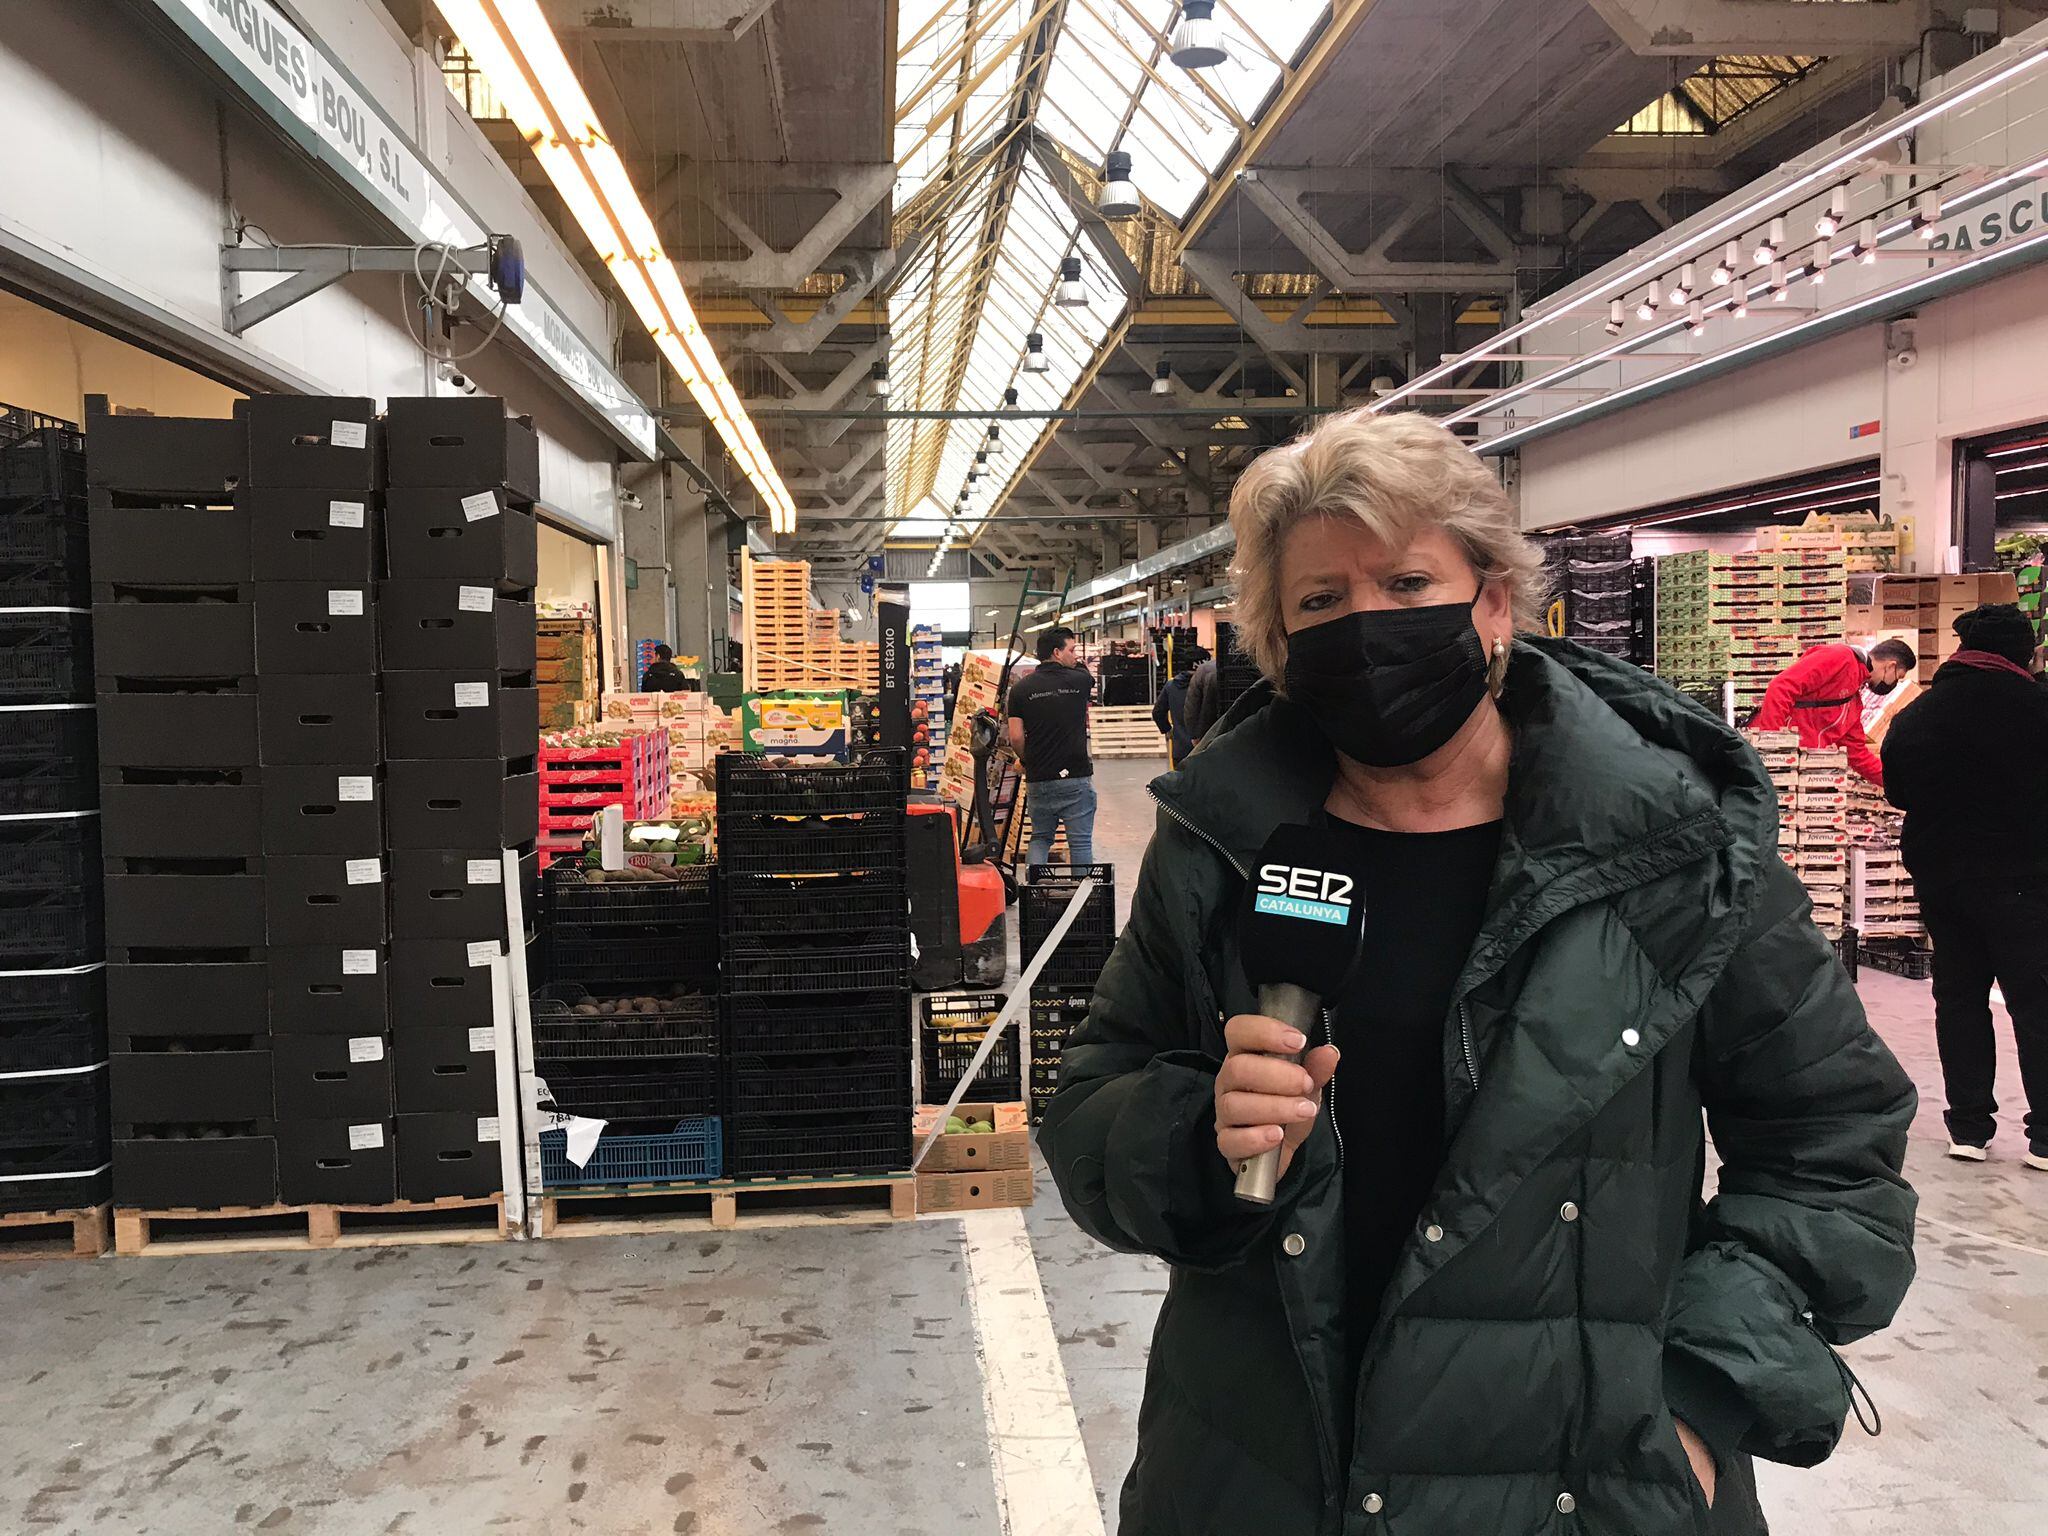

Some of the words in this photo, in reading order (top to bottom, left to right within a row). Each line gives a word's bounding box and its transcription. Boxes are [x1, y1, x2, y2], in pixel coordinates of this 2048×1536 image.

[379, 137, 410, 202] S.L.
[885, 673, 895, 689] BT
[1257, 864, 1354, 905] SER
[1259, 897, 1342, 921] CATALUNYA
[1068, 996, 1086, 1008] ipm
